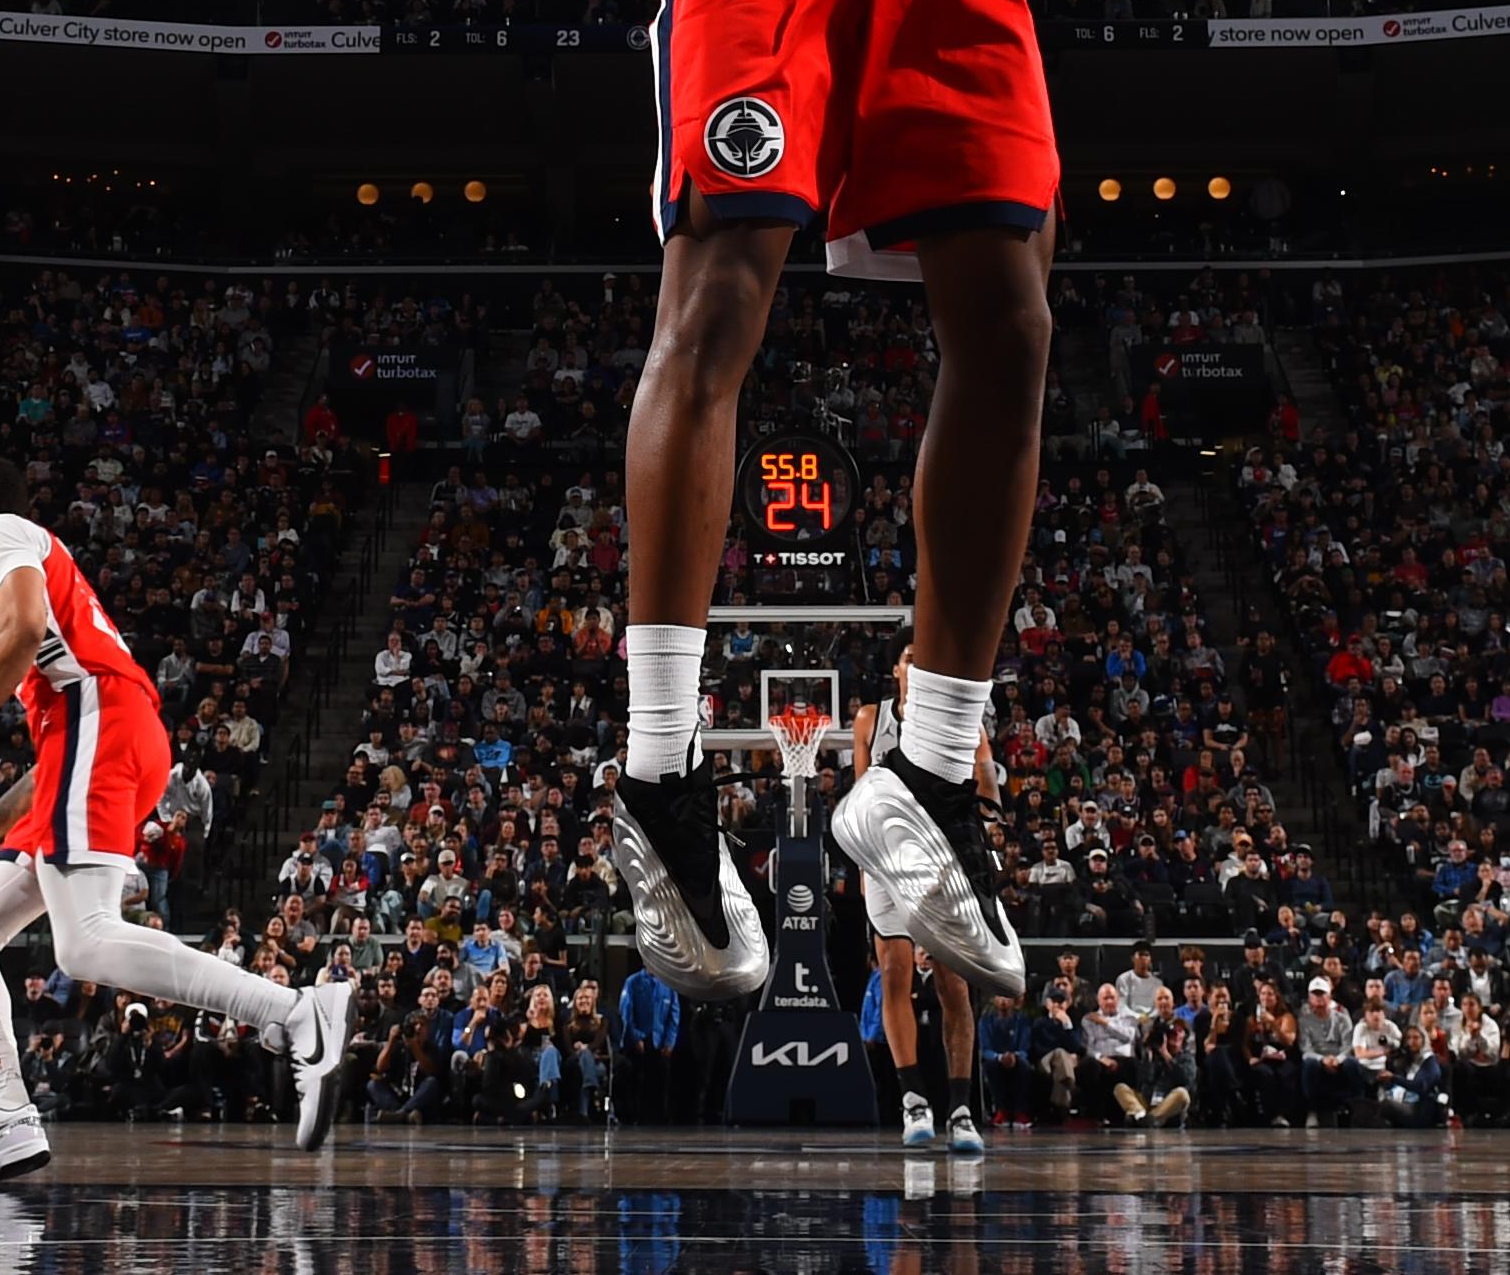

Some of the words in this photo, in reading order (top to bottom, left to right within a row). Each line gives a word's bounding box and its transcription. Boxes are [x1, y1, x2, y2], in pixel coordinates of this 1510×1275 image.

[0, 17, 57, 37] Culver
[64, 21, 99, 43] City
[104, 26, 149, 43] store
[154, 31, 194, 45] now
[198, 34, 246, 52] open
[429, 30, 440, 47] 2
[497, 30, 508, 47] 6
[556, 30, 580, 47] 23
[1103, 25, 1115, 43] 6
[1171, 25, 1184, 42] 2
[1220, 27, 1266, 43] store
[1271, 29, 1311, 42] now
[1315, 26, 1364, 45] open
[284, 39, 326, 49] turbotax
[377, 354, 417, 365] INTUIT
[376, 365, 438, 379] turbotax
[761, 454, 818, 480] 55.8
[767, 482, 832, 530] 24
[778, 552, 846, 566] TISSOT
[782, 916, 819, 930] AT&T
[751, 1041, 849, 1066] KIA
